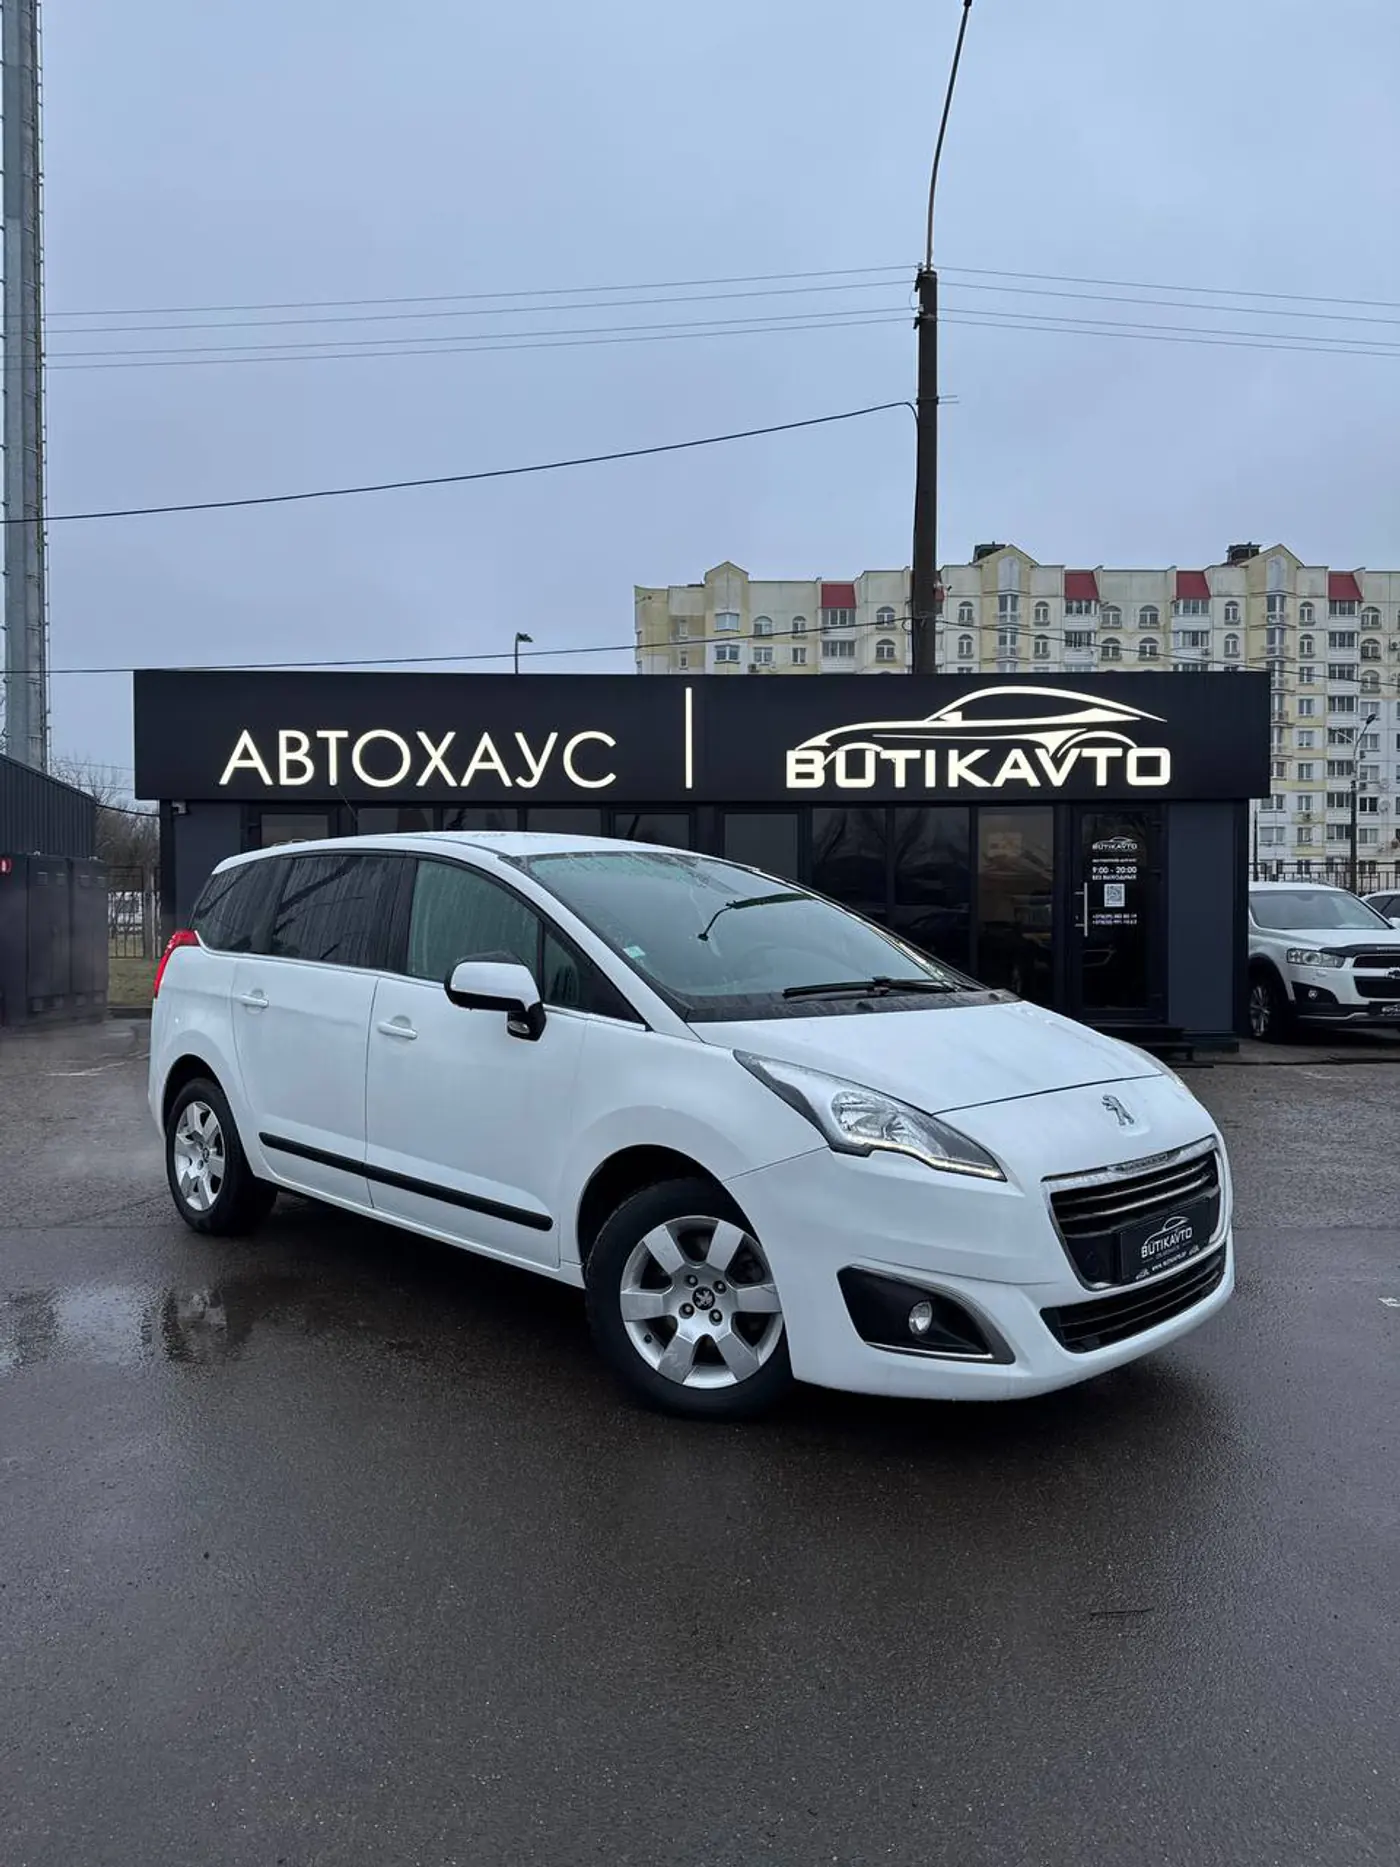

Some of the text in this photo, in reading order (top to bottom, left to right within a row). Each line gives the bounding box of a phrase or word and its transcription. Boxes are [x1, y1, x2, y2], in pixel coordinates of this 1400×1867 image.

[219, 729, 617, 789] АВТОХАУС
[786, 746, 1171, 789] BUTIKAVTO
[1141, 1227, 1193, 1258] BUTIKAVTO
